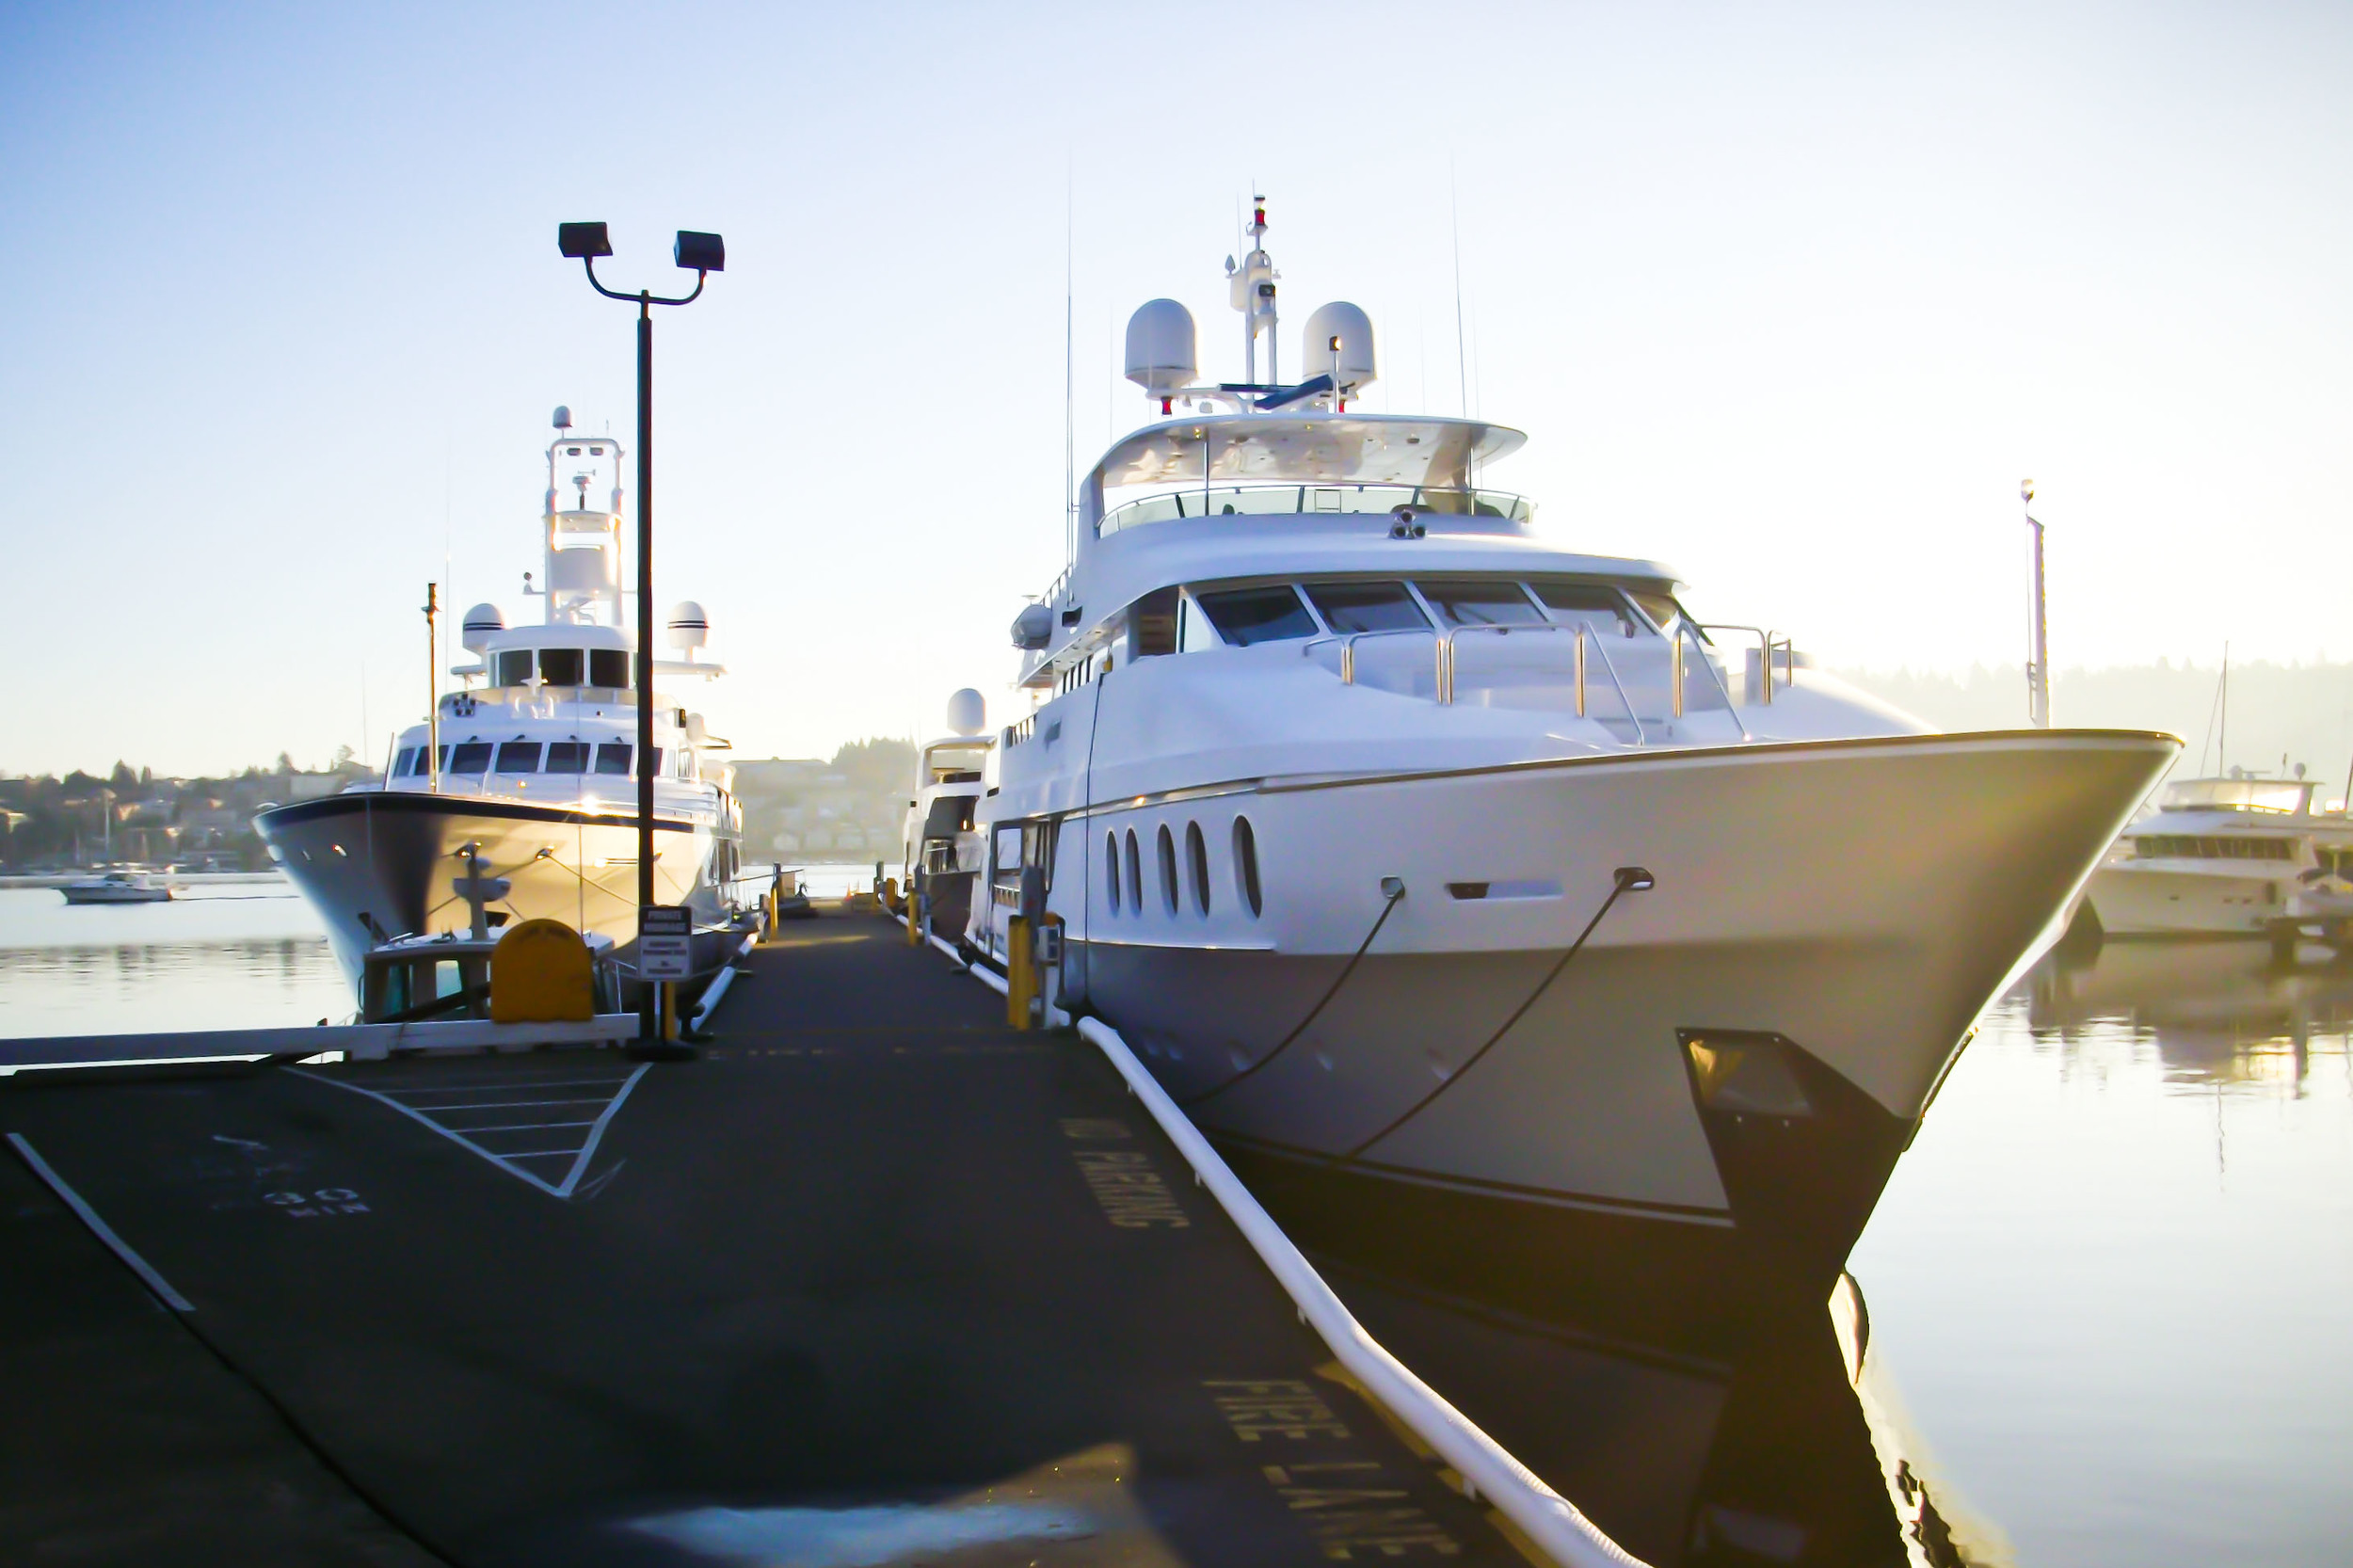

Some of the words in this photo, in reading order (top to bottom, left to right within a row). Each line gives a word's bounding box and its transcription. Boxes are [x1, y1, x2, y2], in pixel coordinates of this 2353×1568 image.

[1072, 1151, 1191, 1227] PARKING
[1201, 1380, 1352, 1442] FIRE
[1262, 1461, 1462, 1560] LANE
